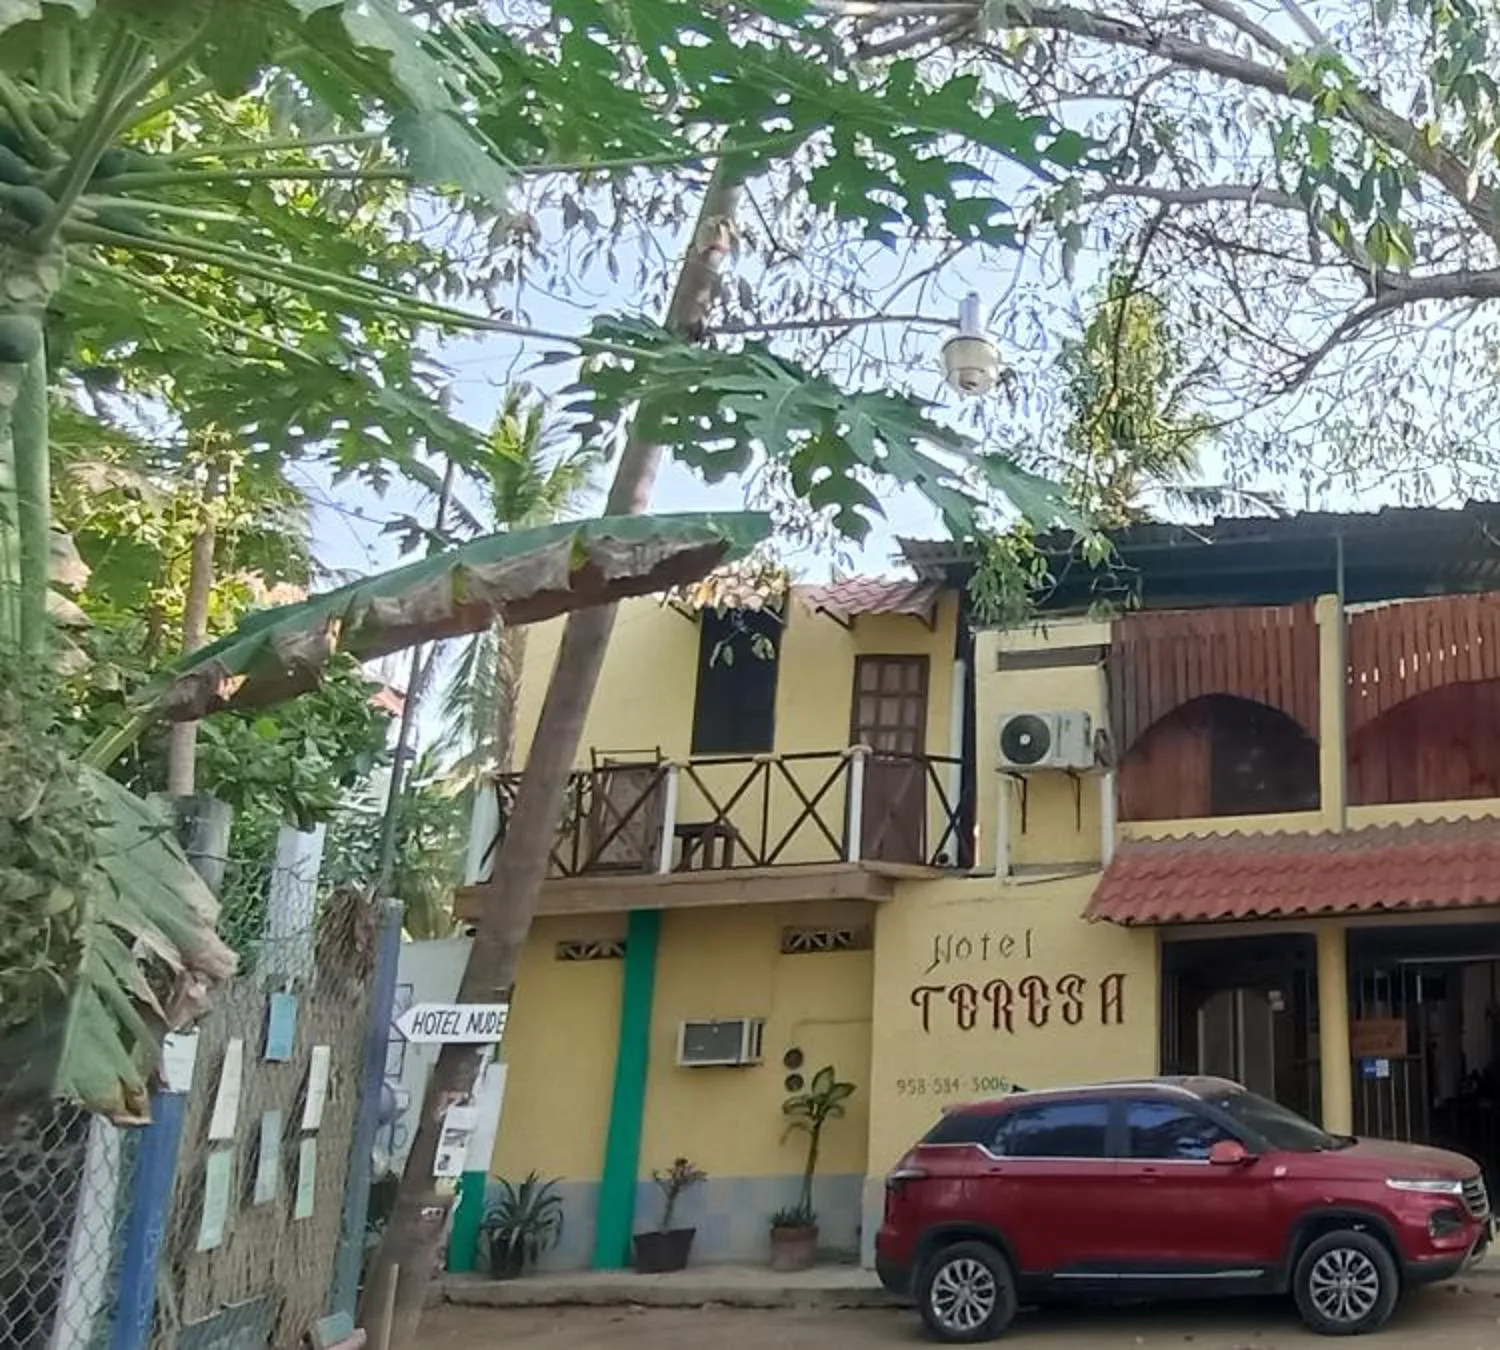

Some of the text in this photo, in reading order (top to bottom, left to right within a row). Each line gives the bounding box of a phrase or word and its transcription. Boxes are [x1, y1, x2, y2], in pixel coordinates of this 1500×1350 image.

[924, 927, 1032, 975] Hotel
[411, 1010, 508, 1036] HOTEL NUDE
[910, 972, 1128, 1035] TERESA
